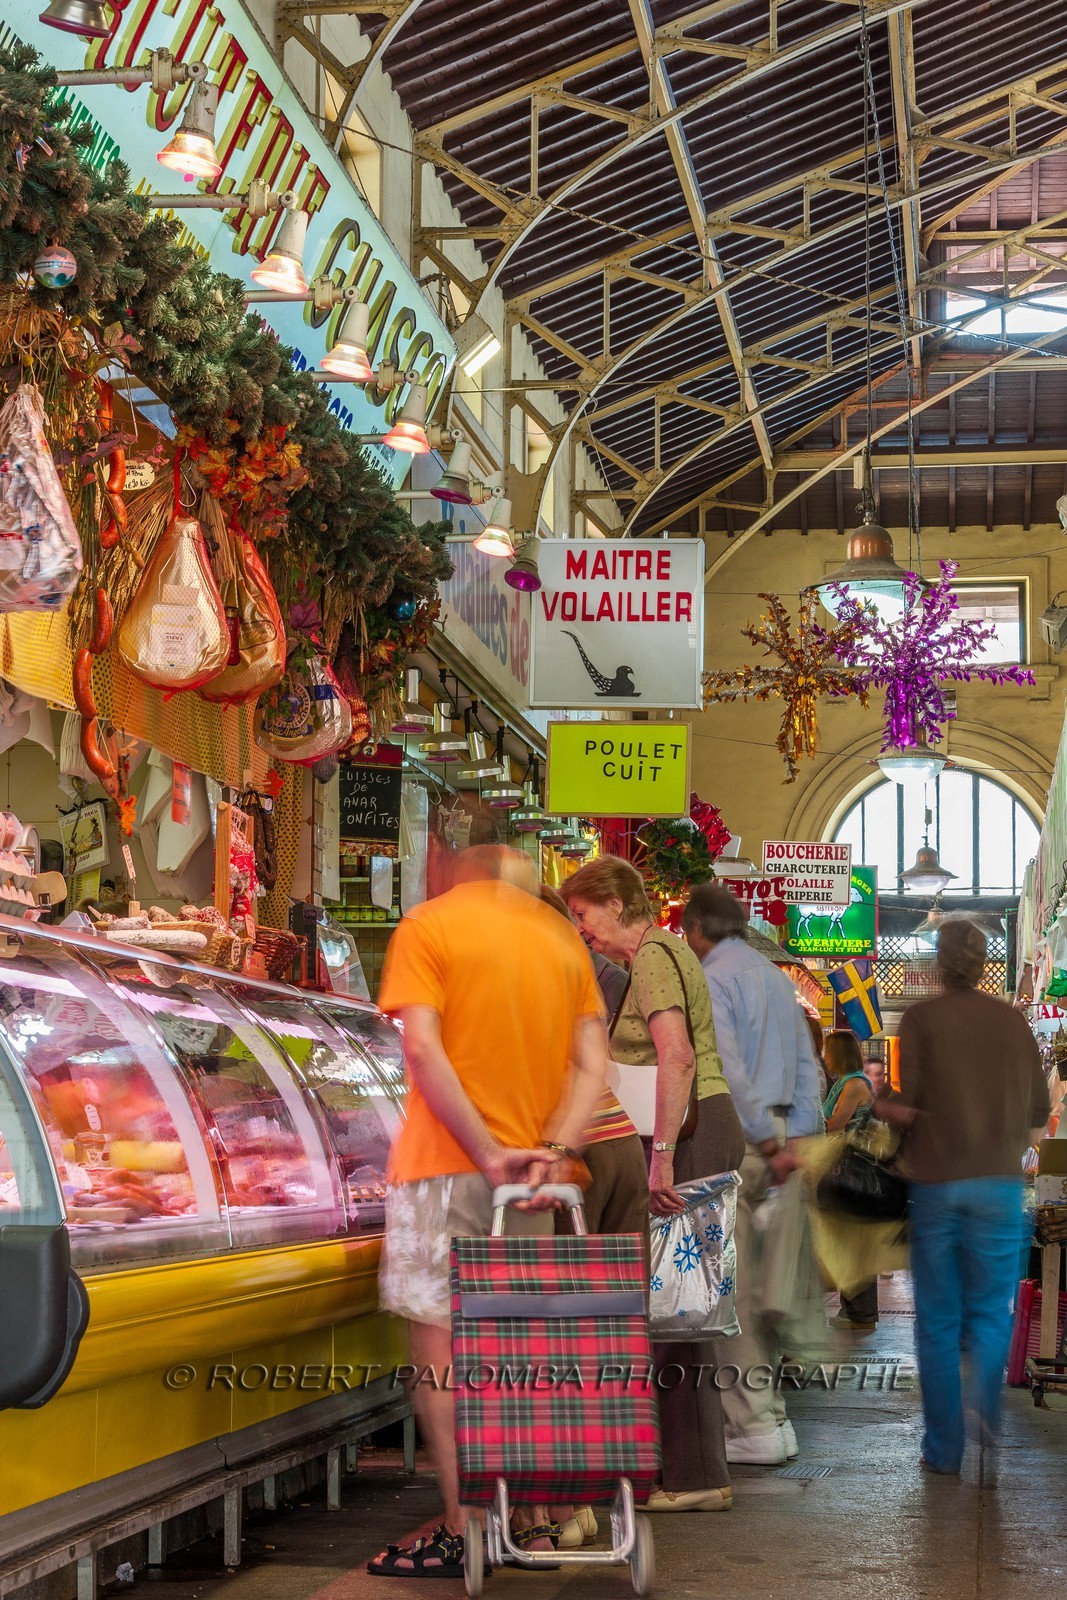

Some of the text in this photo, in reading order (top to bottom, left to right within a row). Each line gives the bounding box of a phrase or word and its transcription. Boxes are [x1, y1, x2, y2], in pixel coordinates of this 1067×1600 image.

[566, 550, 671, 580] MAITRE
[541, 592, 692, 622] VOLAILLER
[585, 740, 682, 760] POULET
[350, 782, 368, 796] DE
[340, 796, 377, 811] ANAR
[339, 811, 400, 829] ONFITES
[766, 844, 848, 861] BOUCHERIE
[766, 863, 848, 875] CHARCUTERIE
[851, 875, 873, 895] RGER
[788, 938, 872, 948] CAVERIVIERE
